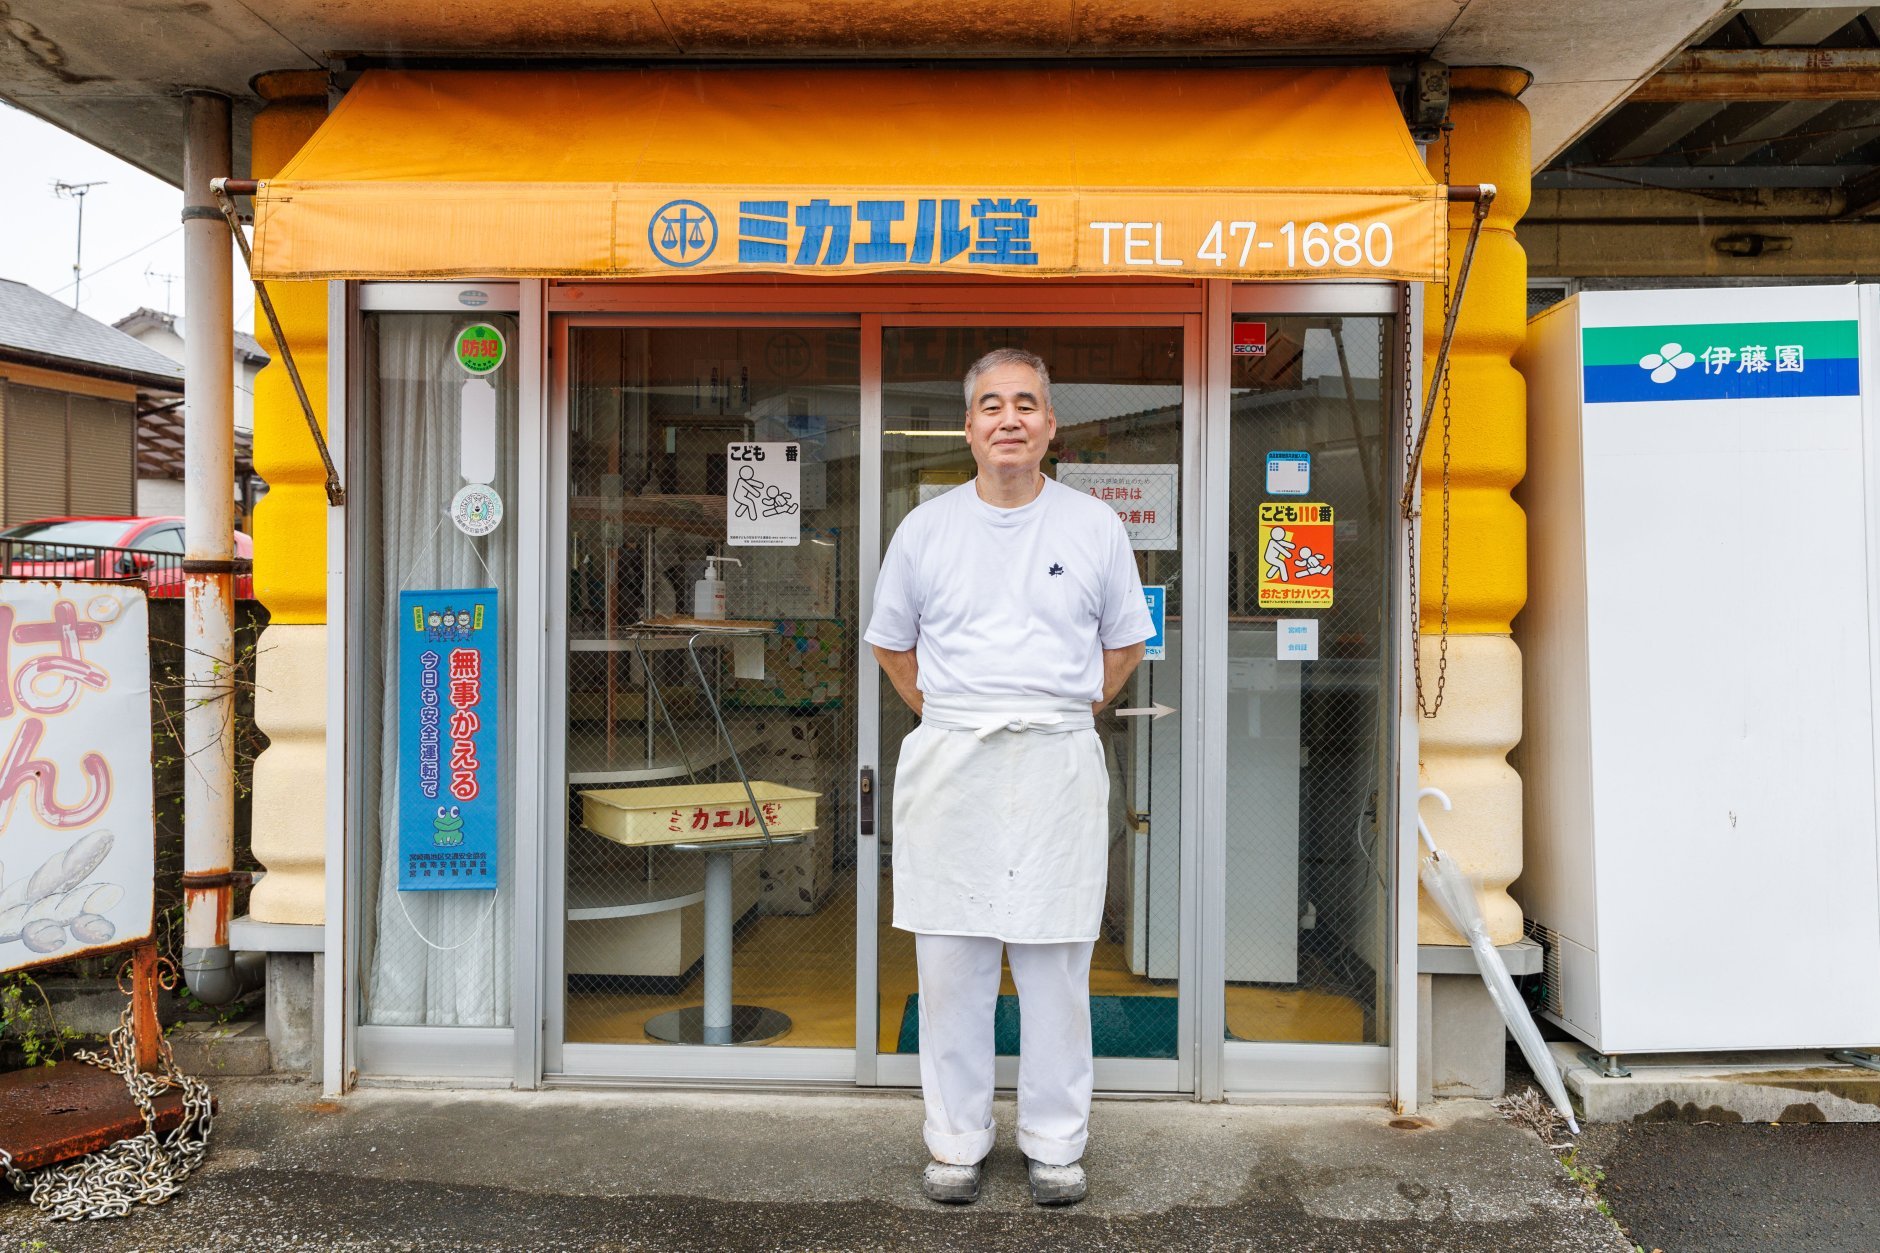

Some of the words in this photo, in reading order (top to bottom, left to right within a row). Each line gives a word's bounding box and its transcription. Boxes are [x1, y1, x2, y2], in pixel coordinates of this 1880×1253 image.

[738, 198, 1038, 266] ミカエル堂
[1089, 221, 1184, 266] TEL
[1197, 220, 1393, 268] 47-1680
[461, 339, 498, 358] 防犯
[1235, 345, 1264, 353] SECOM
[1700, 344, 1804, 375] 伊藤園
[731, 446, 766, 462] こども
[785, 446, 798, 462] 番
[1261, 504, 1332, 523] こども110番
[1260, 588, 1331, 600] おたすけハウス
[0, 596, 119, 829] ぱん
[420, 650, 440, 798] 今日も安全運転で
[449, 648, 481, 801] 無事かえる
